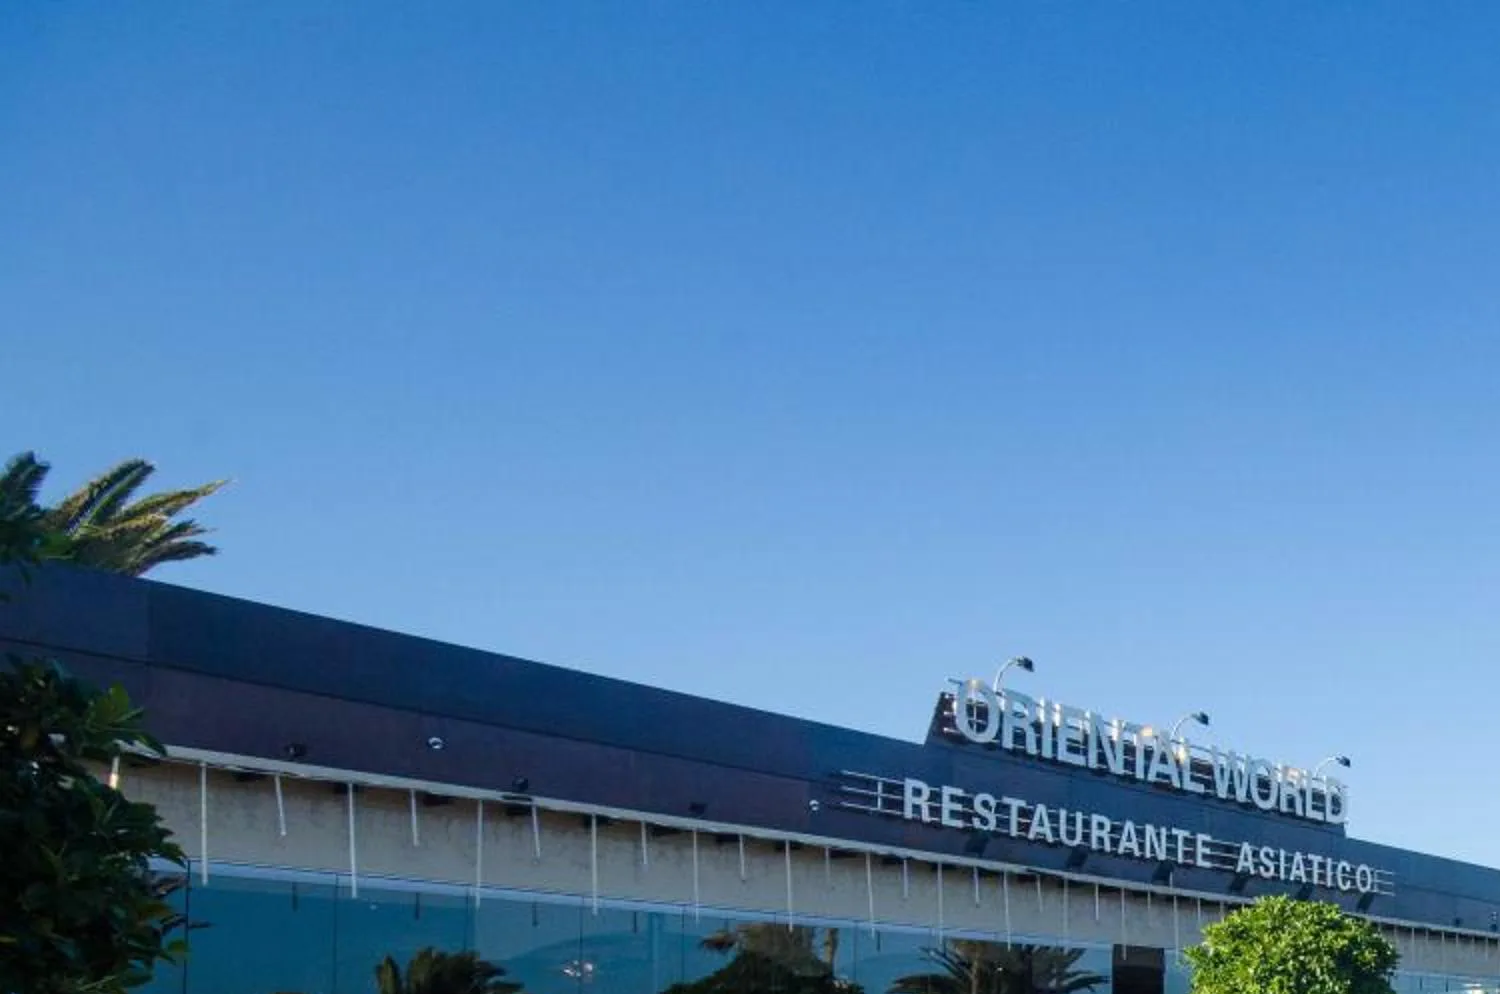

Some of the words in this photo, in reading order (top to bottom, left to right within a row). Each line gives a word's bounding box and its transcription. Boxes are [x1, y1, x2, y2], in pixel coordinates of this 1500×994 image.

[955, 680, 1206, 794] ORIENTAL
[1211, 748, 1348, 824] WORLD
[903, 778, 1212, 867] RESTAURANTE
[1236, 842, 1372, 893] ASIATICO
